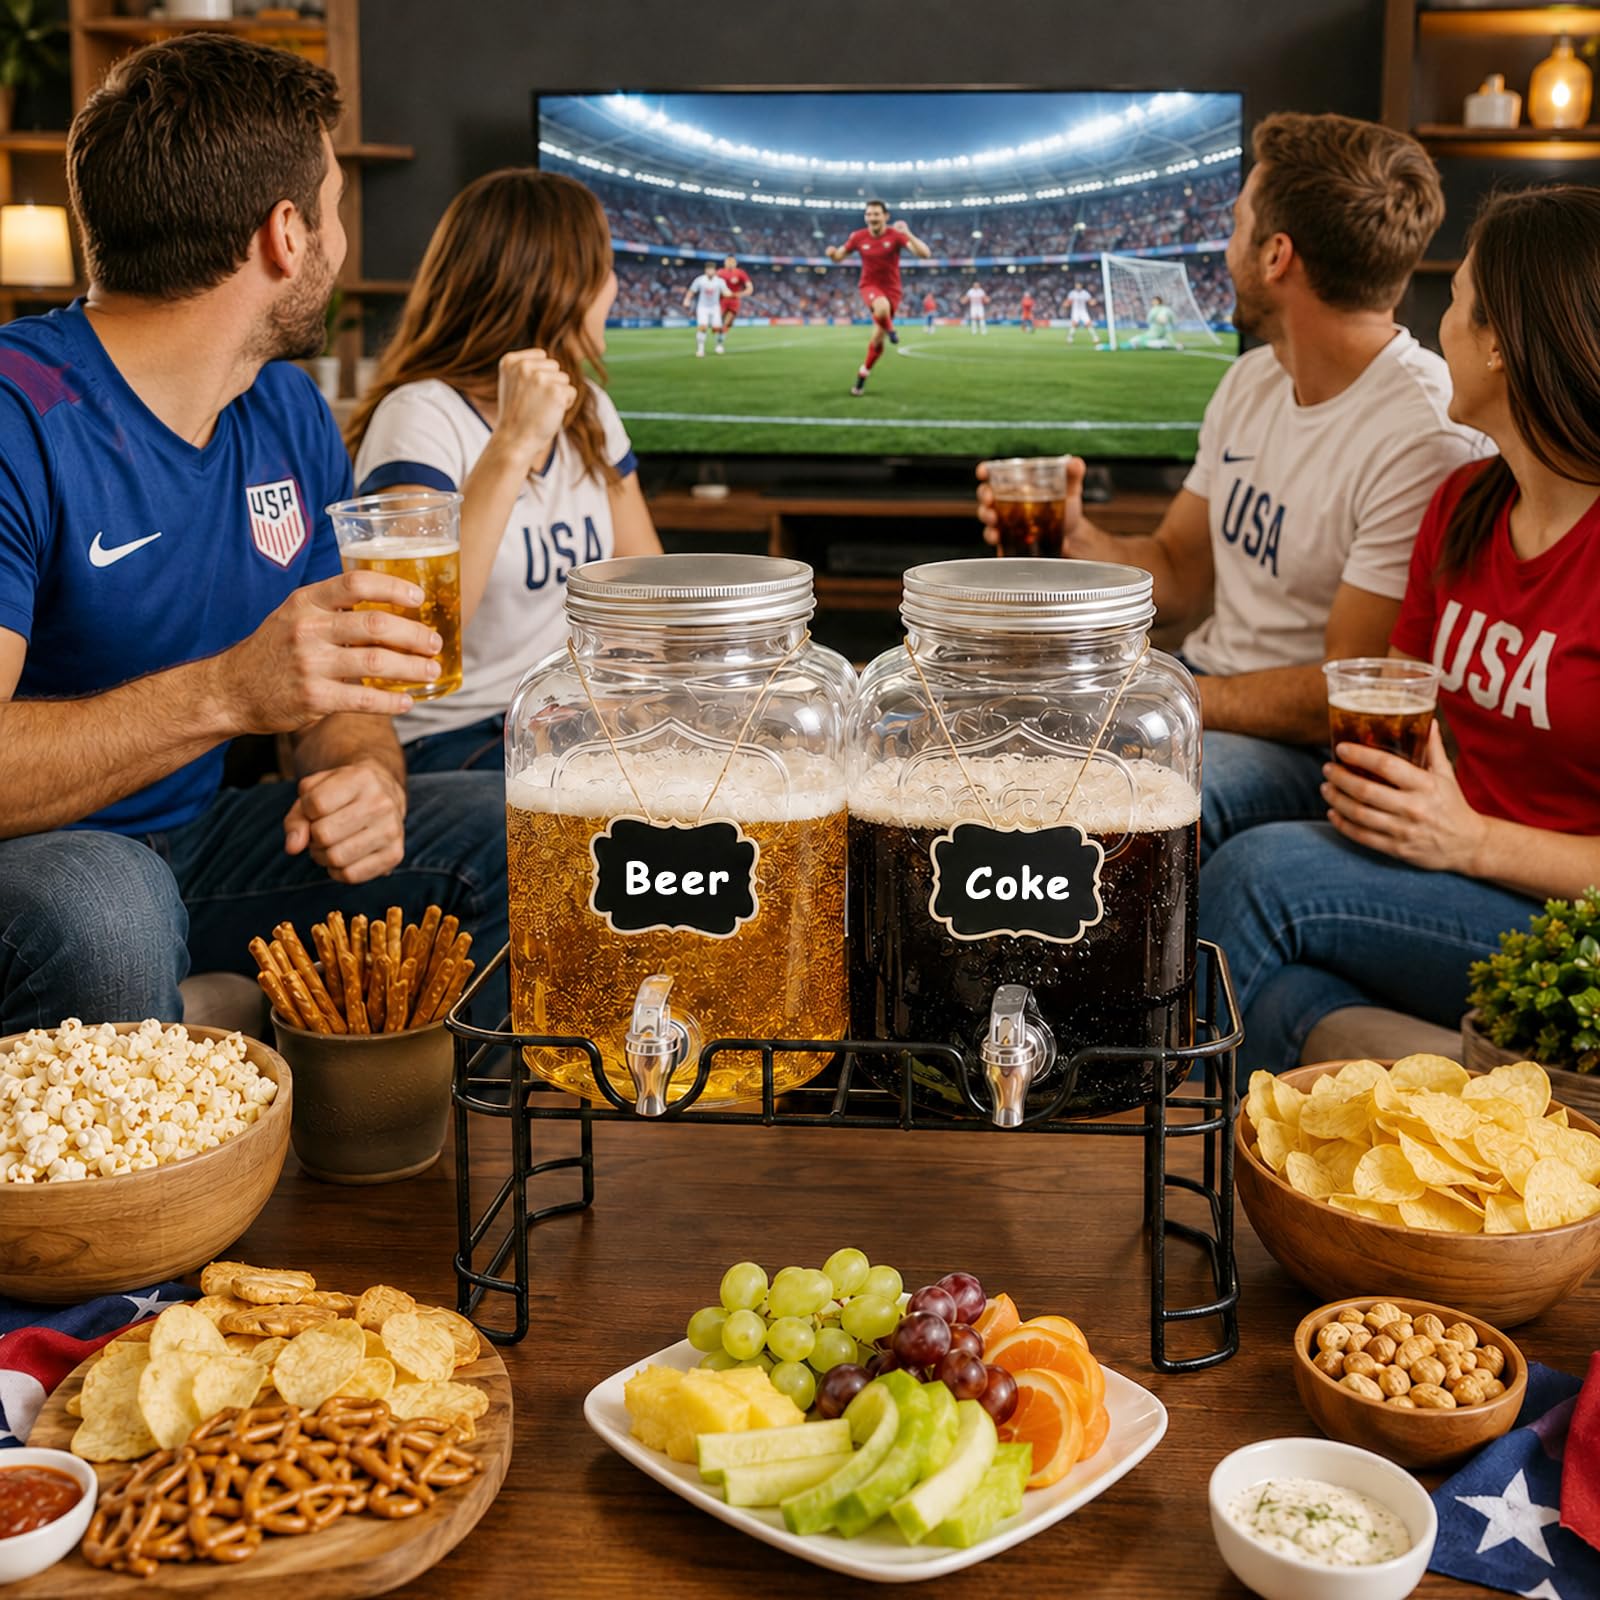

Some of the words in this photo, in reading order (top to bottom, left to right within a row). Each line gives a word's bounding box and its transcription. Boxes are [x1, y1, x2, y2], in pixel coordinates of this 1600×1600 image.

[250, 486, 294, 520] USA
[1222, 478, 1286, 578] USA
[523, 516, 603, 590] USA
[1432, 599, 1557, 731] USA
[625, 860, 730, 896] Beer
[965, 864, 1071, 901] Coke
